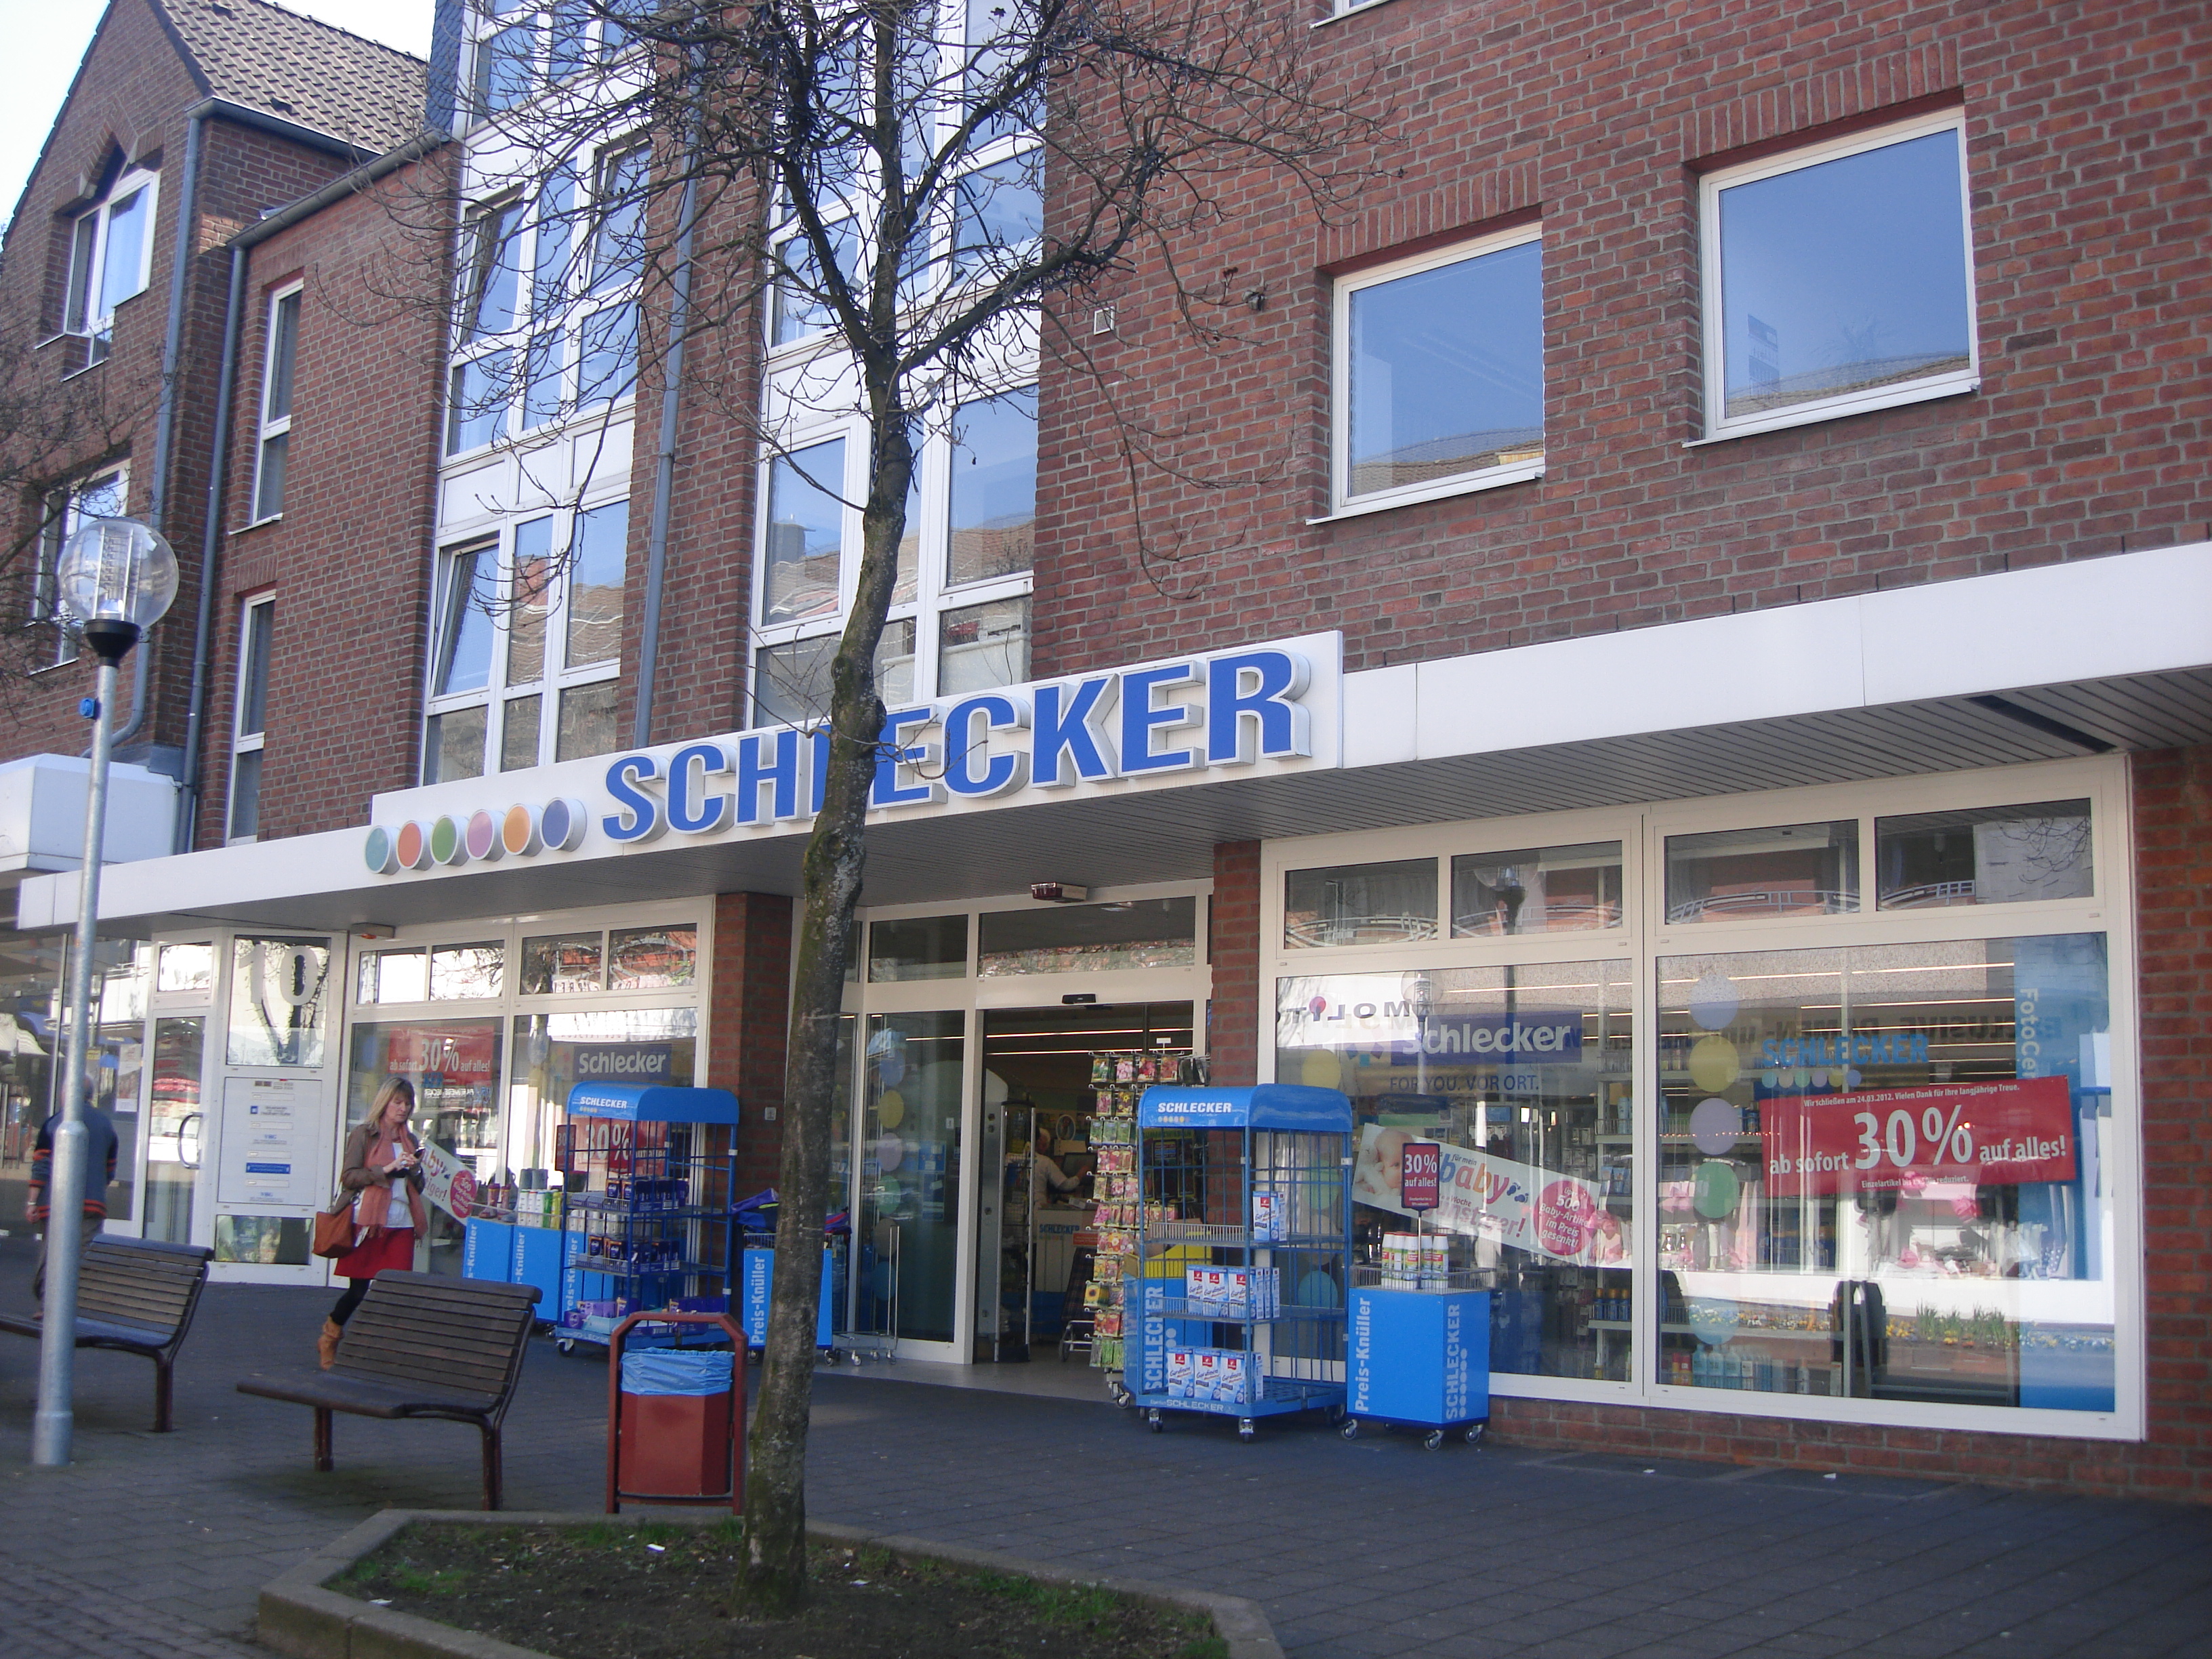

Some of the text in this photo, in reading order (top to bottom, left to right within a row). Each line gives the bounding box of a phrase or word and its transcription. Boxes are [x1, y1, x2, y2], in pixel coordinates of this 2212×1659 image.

[239, 944, 318, 1006] 10
[1761, 1034, 1929, 1067] SCHLECKER
[390, 1059, 398, 1071] ab
[398, 1059, 419, 1071] sofort
[460, 1059, 473, 1071] auf
[473, 1059, 490, 1072] alles!
[579, 1051, 666, 1074] Schlecker
[1465, 1075, 1500, 1091] VOR
[1503, 1074, 1539, 1090] ORT.
[580, 1097, 628, 1109] SCHLECKER
[1816, 1096, 1845, 1107] schließen
[1857, 1094, 1894, 1103] 24.03.2012.
[1895, 1091, 1914, 1100] Vielen
[1916, 1090, 1932, 1099] Dank
[1945, 1088, 1959, 1096] Ihre
[1960, 1086, 1998, 1096] langjährige
[1999, 1084, 2020, 1092] Treue.
[1158, 1102, 1232, 1113] SCHLECKER
[1452, 1153, 1462, 1163] für
[1463, 1158, 1477, 1166] mein
[1769, 1153, 1791, 1175] ab
[1796, 1151, 1849, 1174] sofort
[1980, 1139, 2011, 1162] auf
[2015, 1135, 2066, 1160] alles!
[1405, 1176, 1437, 1187] auf alles!
[1439, 1153, 1510, 1204] baby
[1556, 1194, 1580, 1212] 500
[1546, 1217, 1580, 1237] im Preis
[1541, 1229, 1579, 1248] gesenkt!
[751, 1255, 766, 1345] Preis-Knüller
[1355, 1297, 1371, 1412] Preis-Knüller
[1446, 1303, 1460, 1420] SCHLECKER
[1166, 1399, 1224, 1412] SCHLECKER
